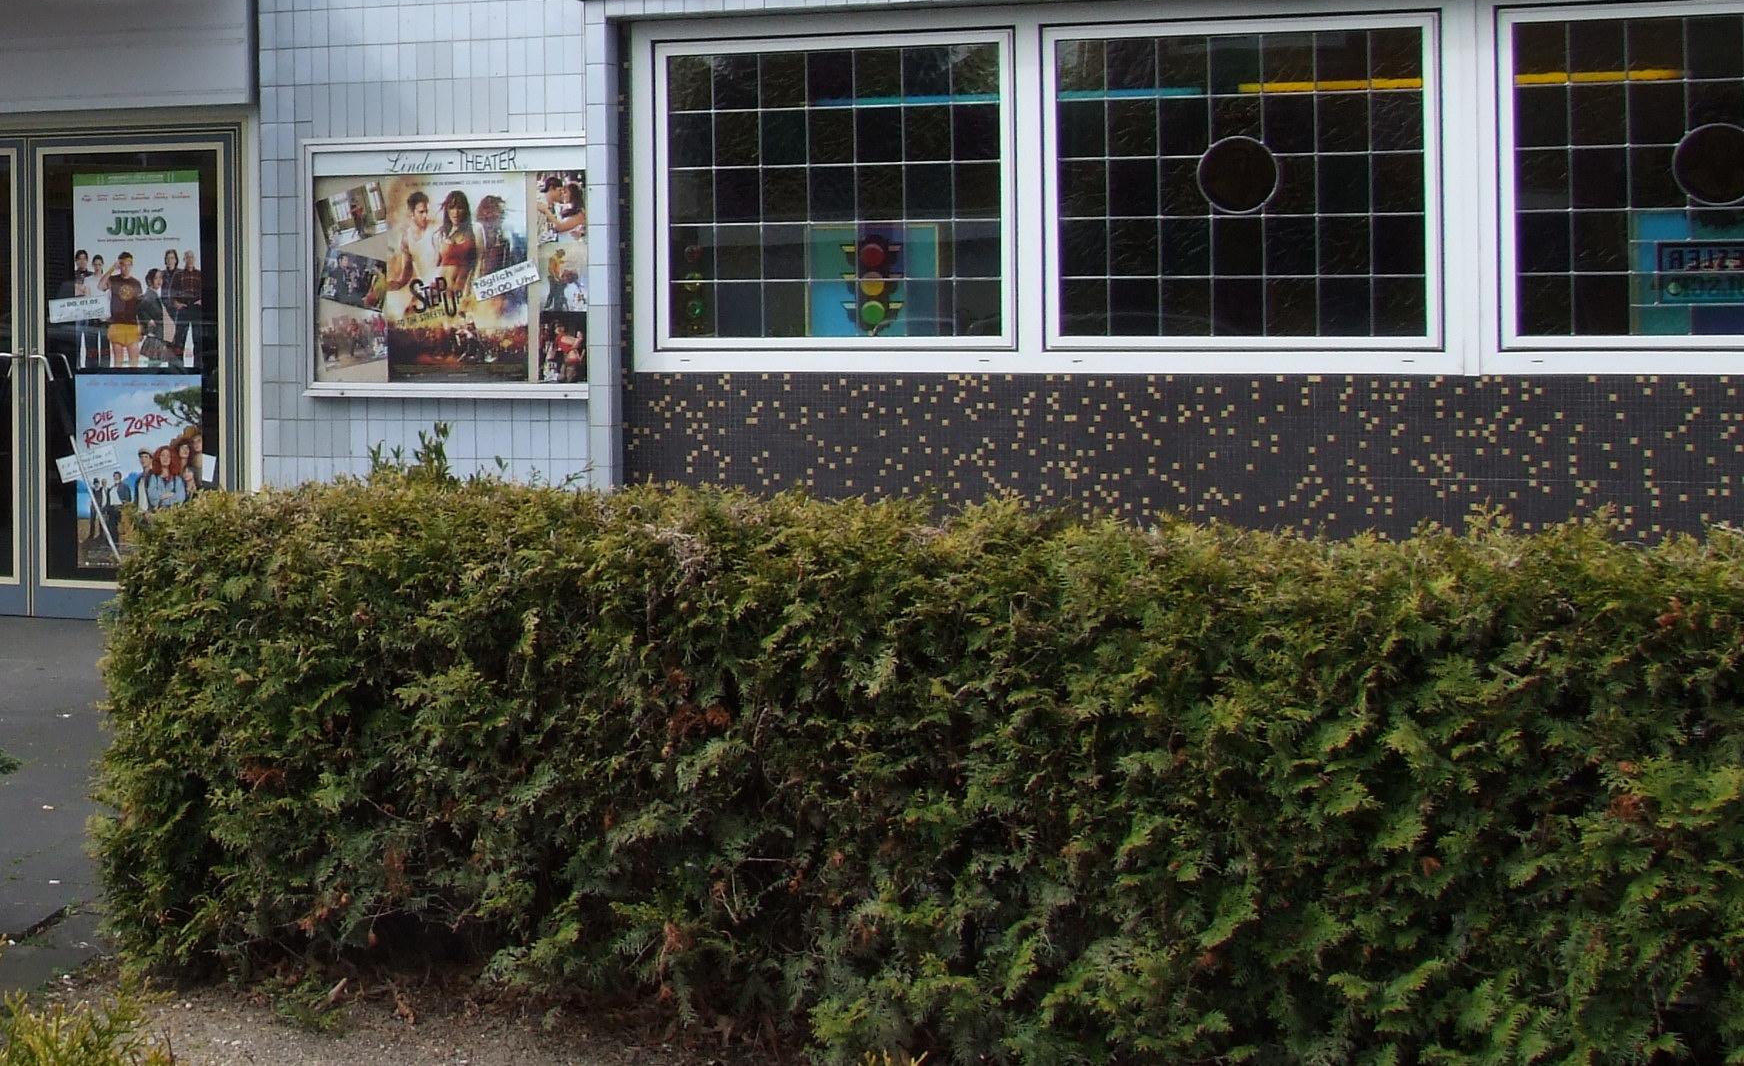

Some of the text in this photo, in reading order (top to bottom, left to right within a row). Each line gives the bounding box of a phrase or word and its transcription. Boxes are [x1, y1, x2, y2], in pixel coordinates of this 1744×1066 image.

[386, 151, 442, 173] Linden
[457, 147, 518, 172] THEATER
[106, 215, 167, 236] JUNO
[92, 410, 114, 426] DIE
[82, 412, 173, 448] ROTE ZORA
